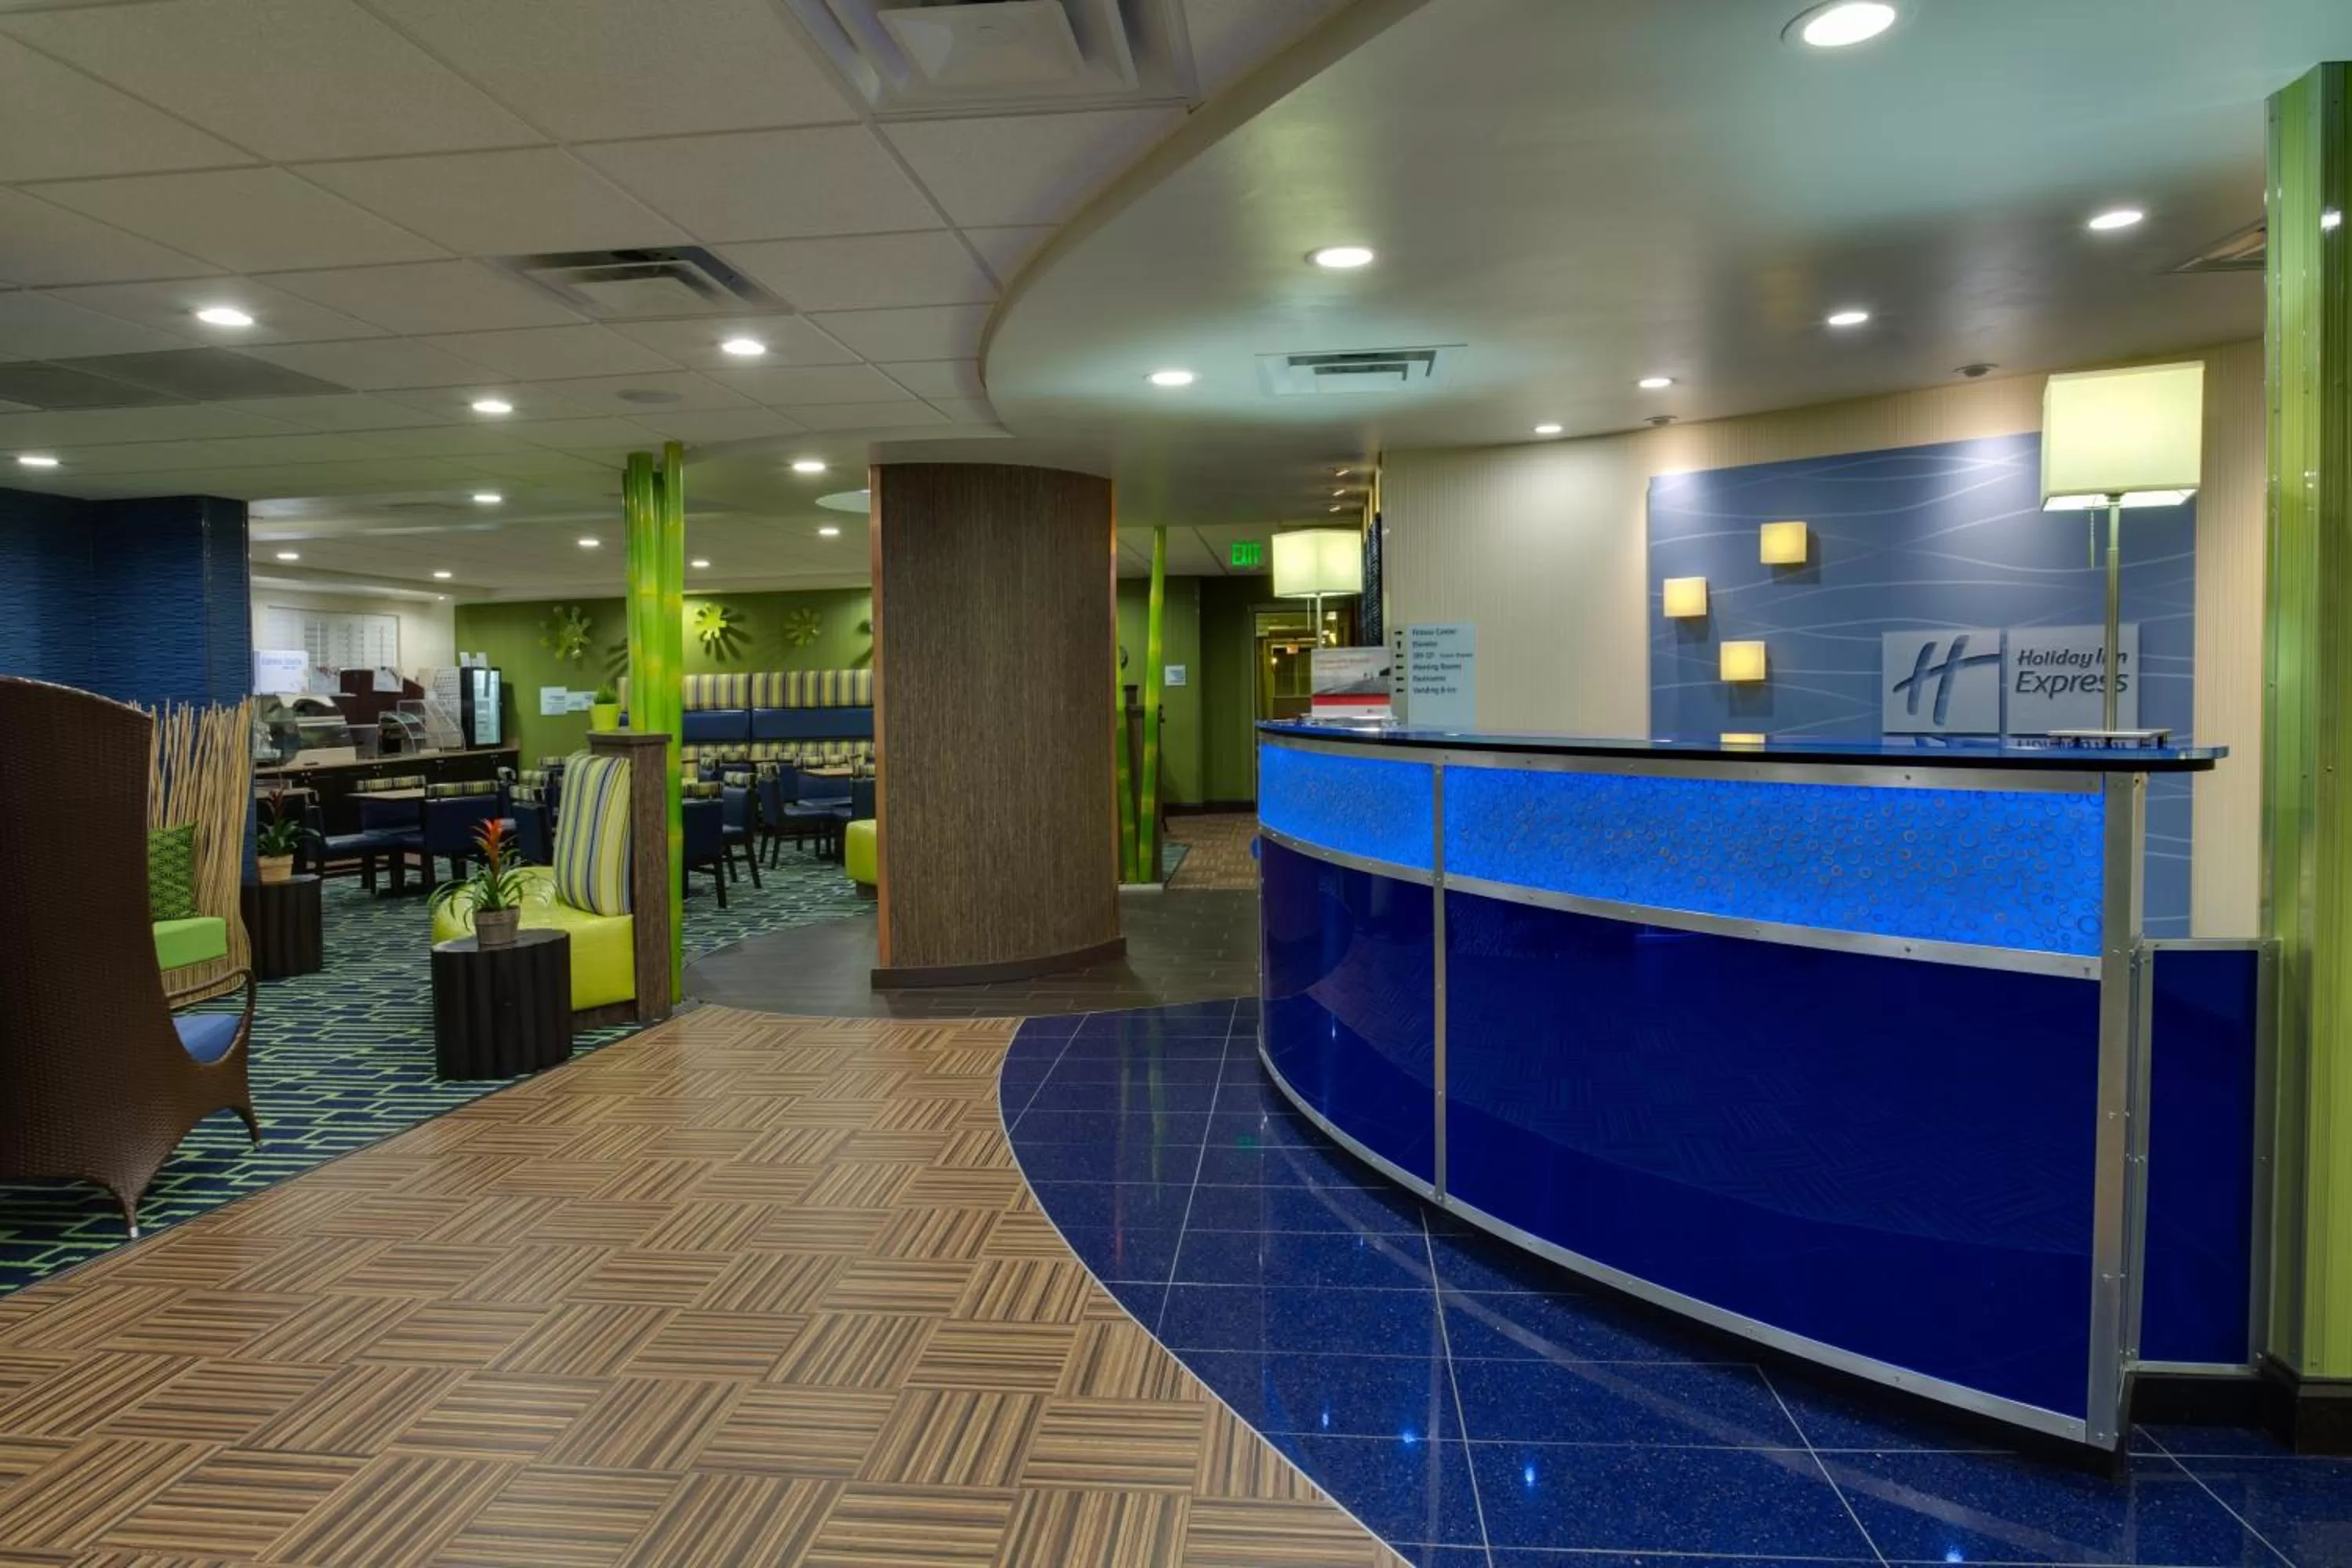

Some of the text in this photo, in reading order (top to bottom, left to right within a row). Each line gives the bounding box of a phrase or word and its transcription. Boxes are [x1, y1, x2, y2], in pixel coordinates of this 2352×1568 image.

[1231, 543, 1261, 565] EXIT
[2017, 647, 2129, 668] Holiday In
